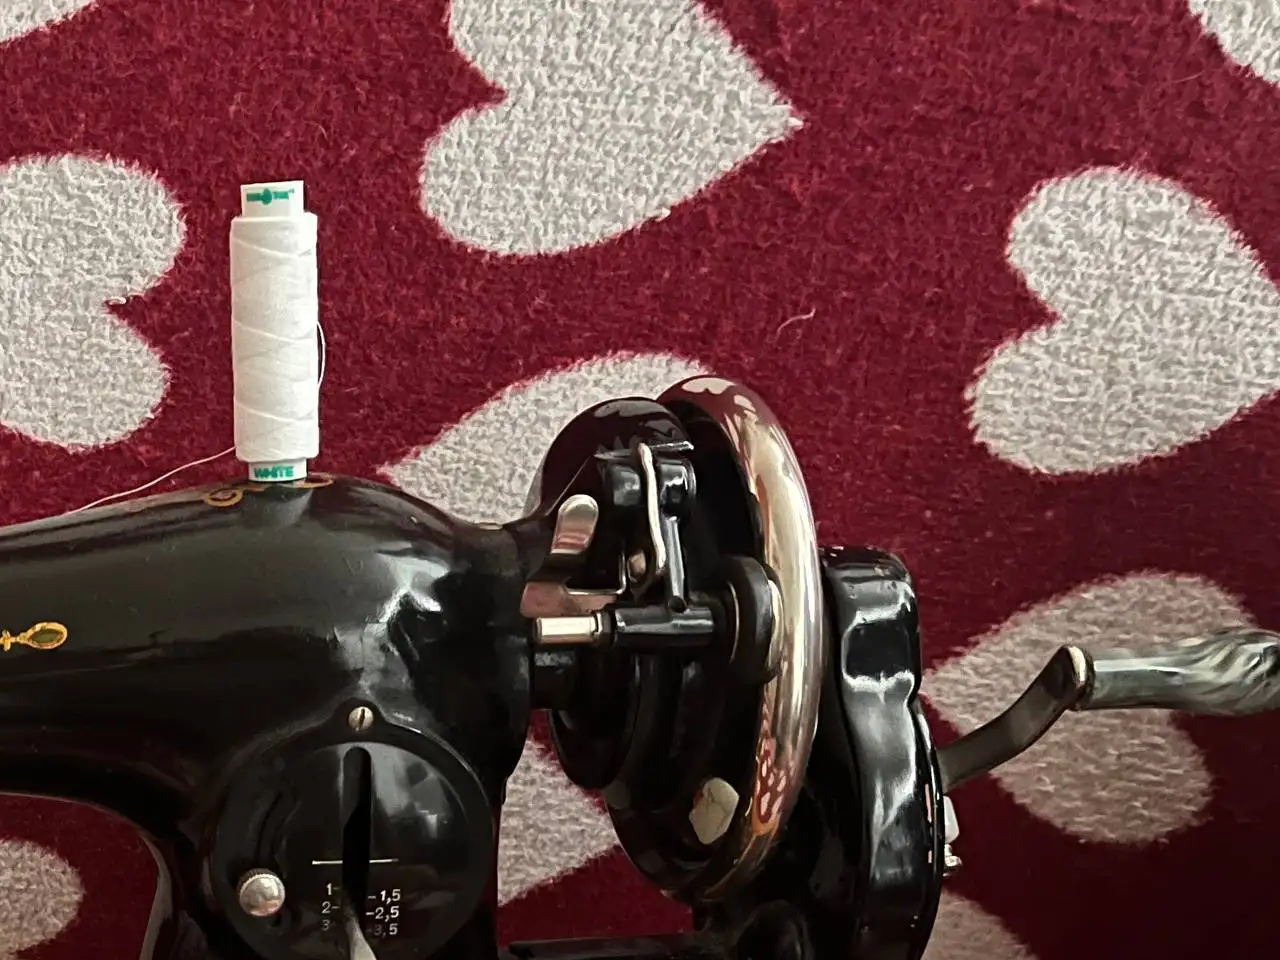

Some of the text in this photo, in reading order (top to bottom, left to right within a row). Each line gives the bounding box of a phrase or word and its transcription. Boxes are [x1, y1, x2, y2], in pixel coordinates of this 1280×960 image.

[253, 464, 294, 478] WHITE
[380, 888, 401, 905] 1,5
[321, 901, 332, 914] 2
[374, 905, 400, 922] 2,5
